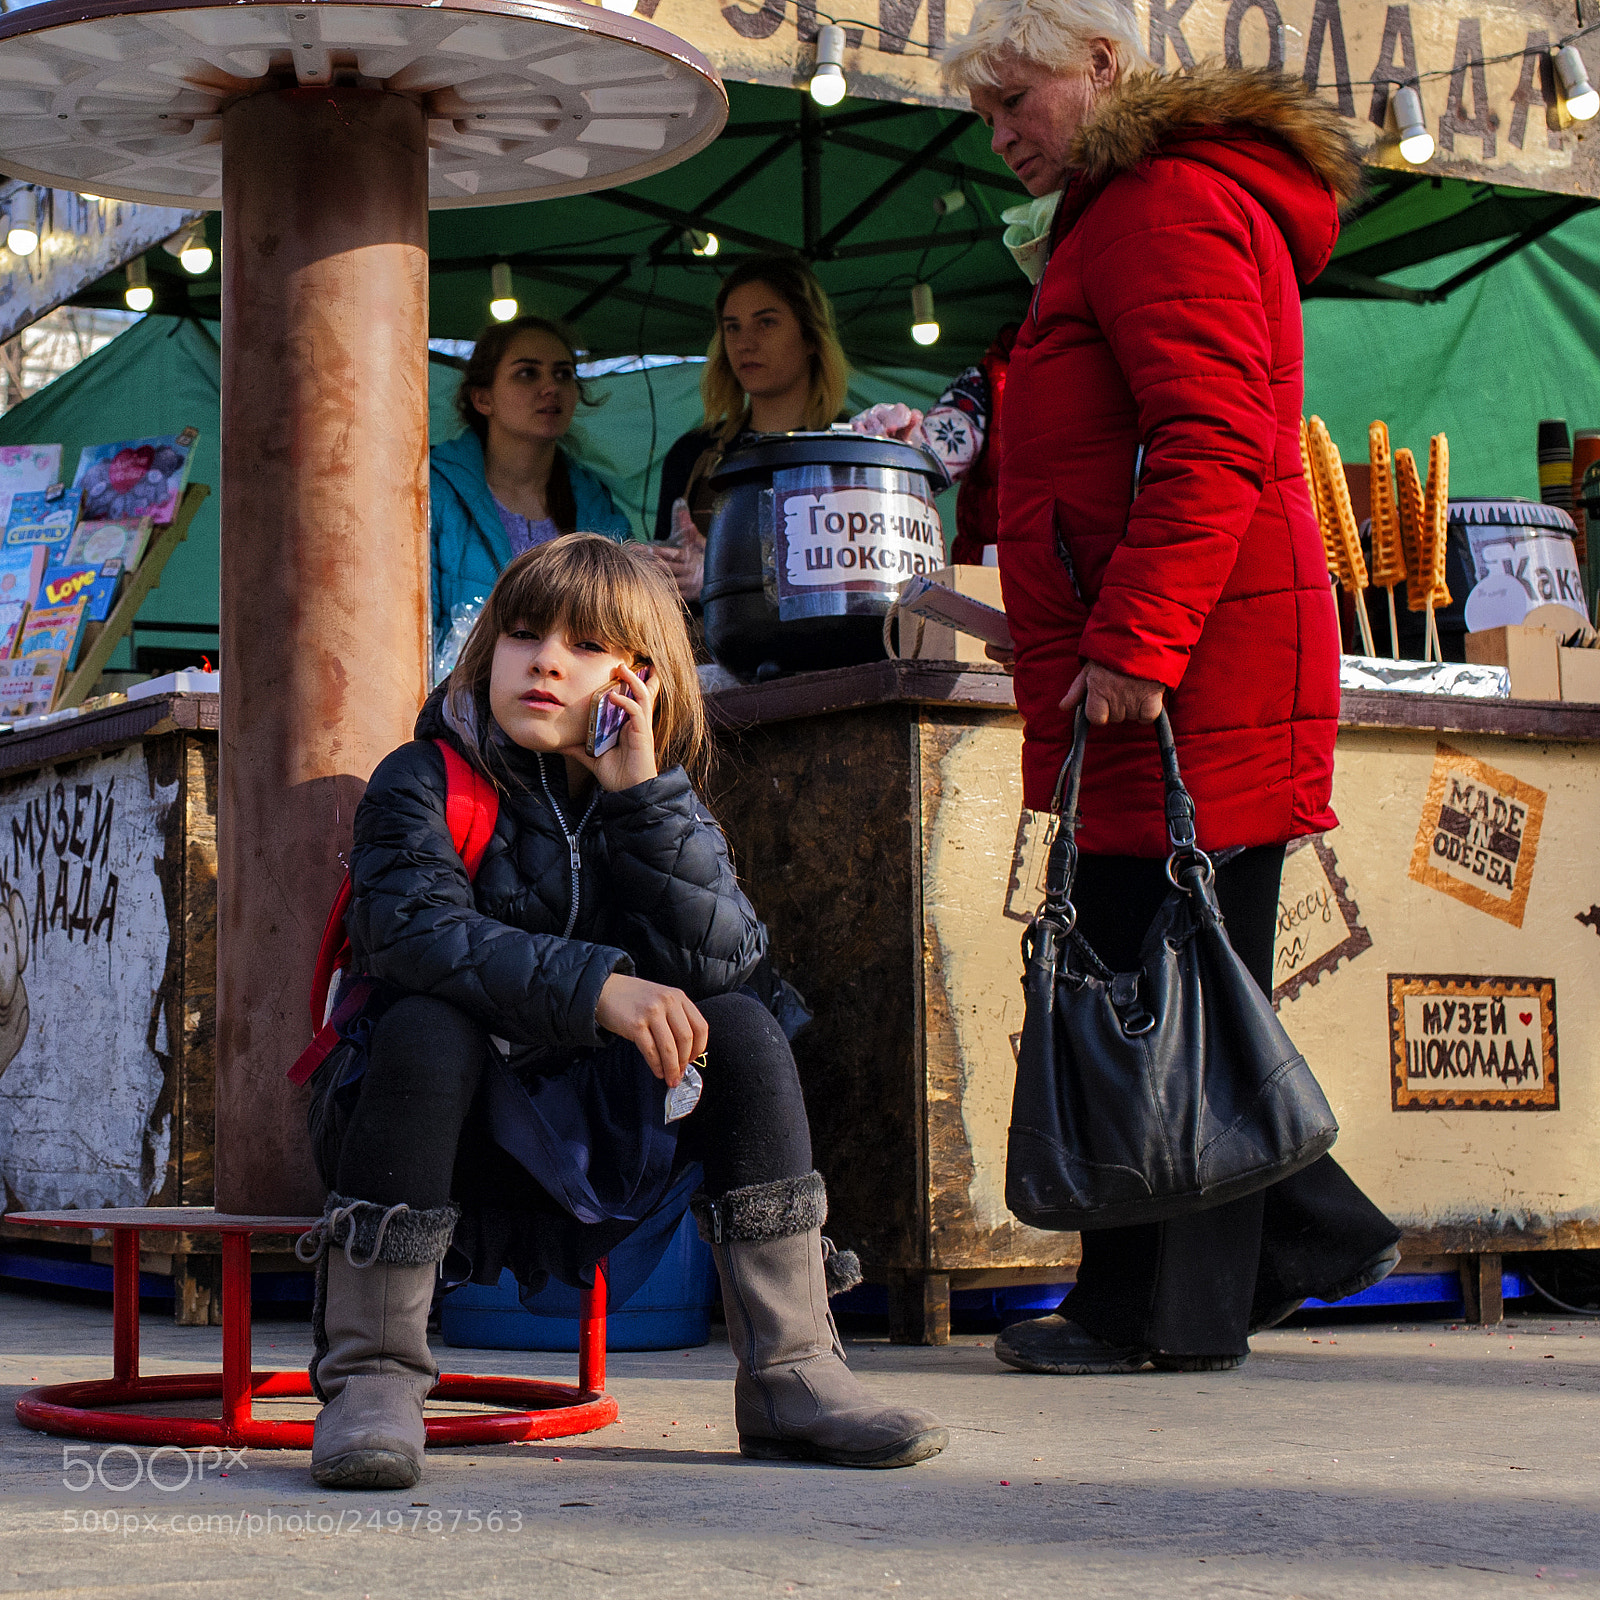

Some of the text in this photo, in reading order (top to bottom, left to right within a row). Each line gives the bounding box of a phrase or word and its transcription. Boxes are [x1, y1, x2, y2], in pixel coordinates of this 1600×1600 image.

[1148, 0, 1565, 159] КОЛАДА
[808, 505, 935, 546] Горячий
[1503, 556, 1585, 601] Кака
[12, 776, 115, 879] МУЗЕЙ
[1448, 778, 1525, 839] MADE
[1464, 814, 1495, 850] IN
[1433, 832, 1514, 891] ODESSA
[1275, 886, 1333, 939] дессу
[1422, 996, 1507, 1035] МУЗЕЙ
[1406, 1037, 1540, 1088] ШОКОЛАДА
